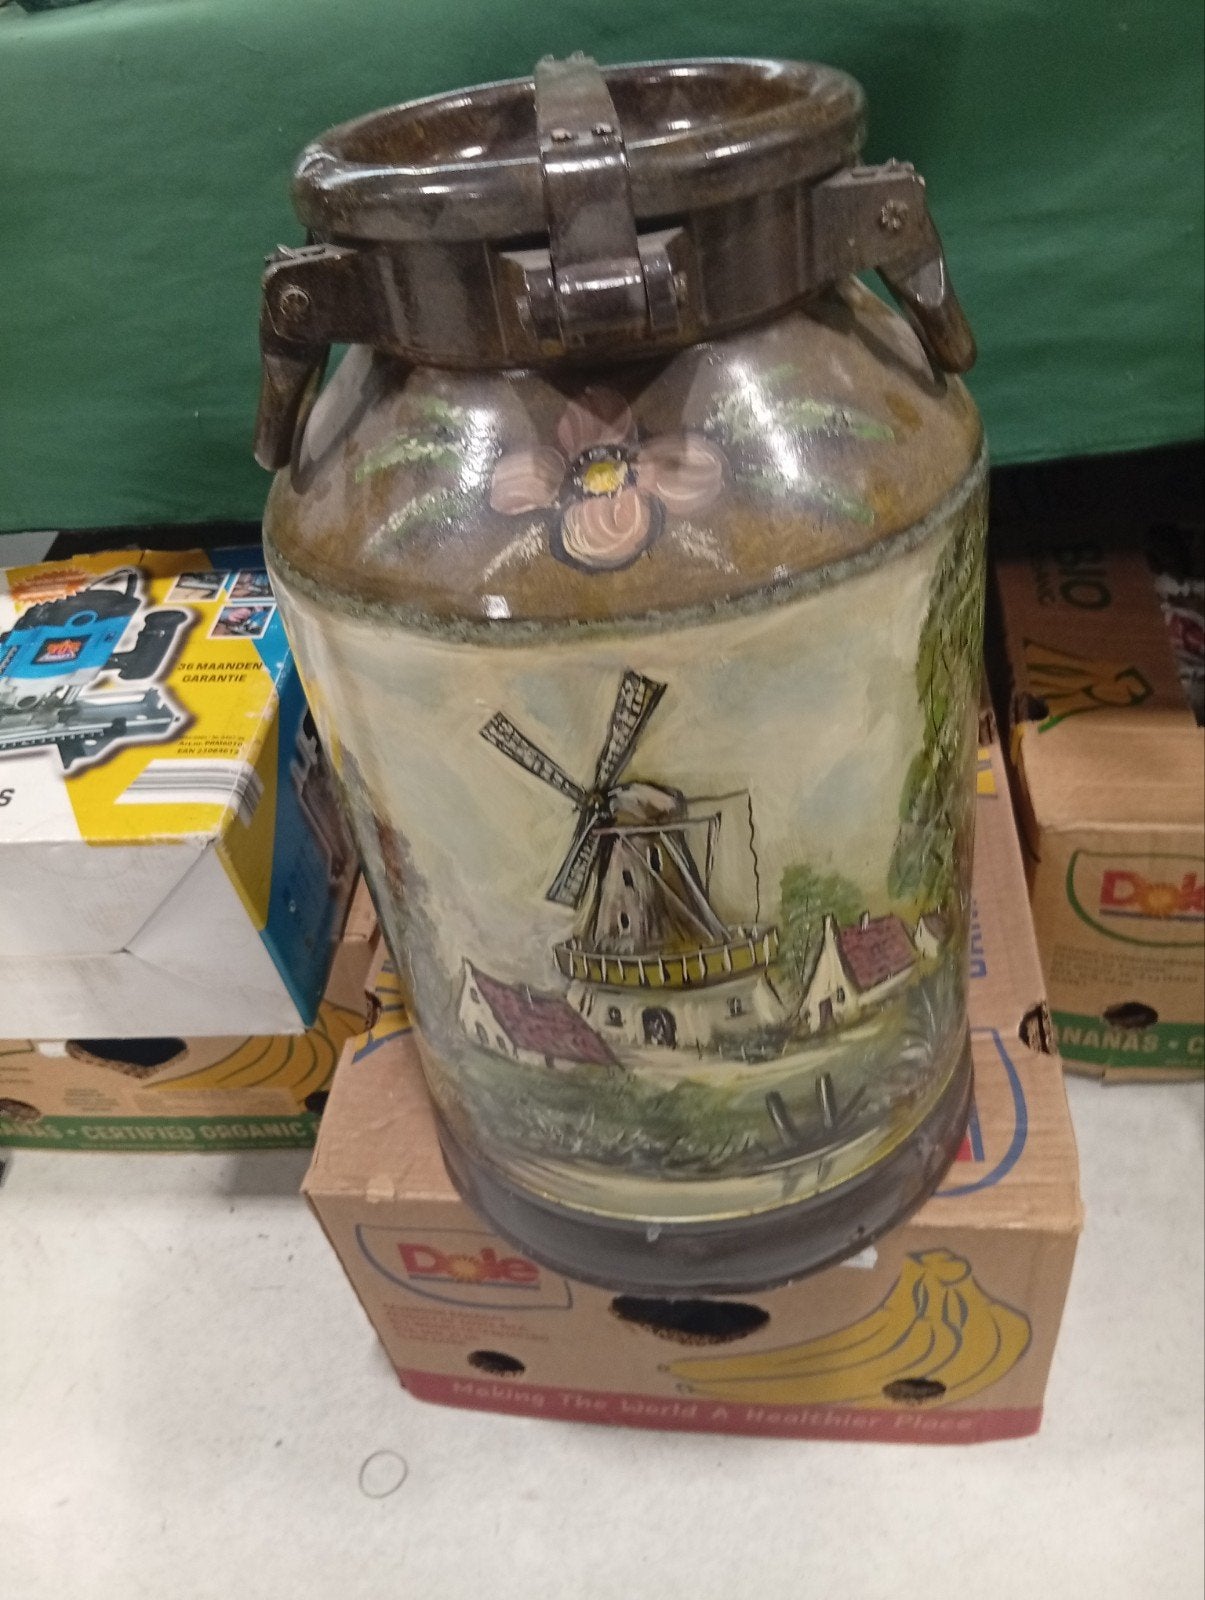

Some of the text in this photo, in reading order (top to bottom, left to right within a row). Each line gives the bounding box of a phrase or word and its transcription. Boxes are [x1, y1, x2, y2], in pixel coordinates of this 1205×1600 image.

[182, 674, 248, 683] GARANTIE
[195, 661, 263, 671] MAANDEN
[1100, 870, 1205, 913] Dol
[81, 1124, 196, 1141] CERTIFIED
[202, 1121, 308, 1140] ORGANIC
[397, 1243, 540, 1284] Dole
[452, 1381, 974, 1431] Making The World A Healthier Place
